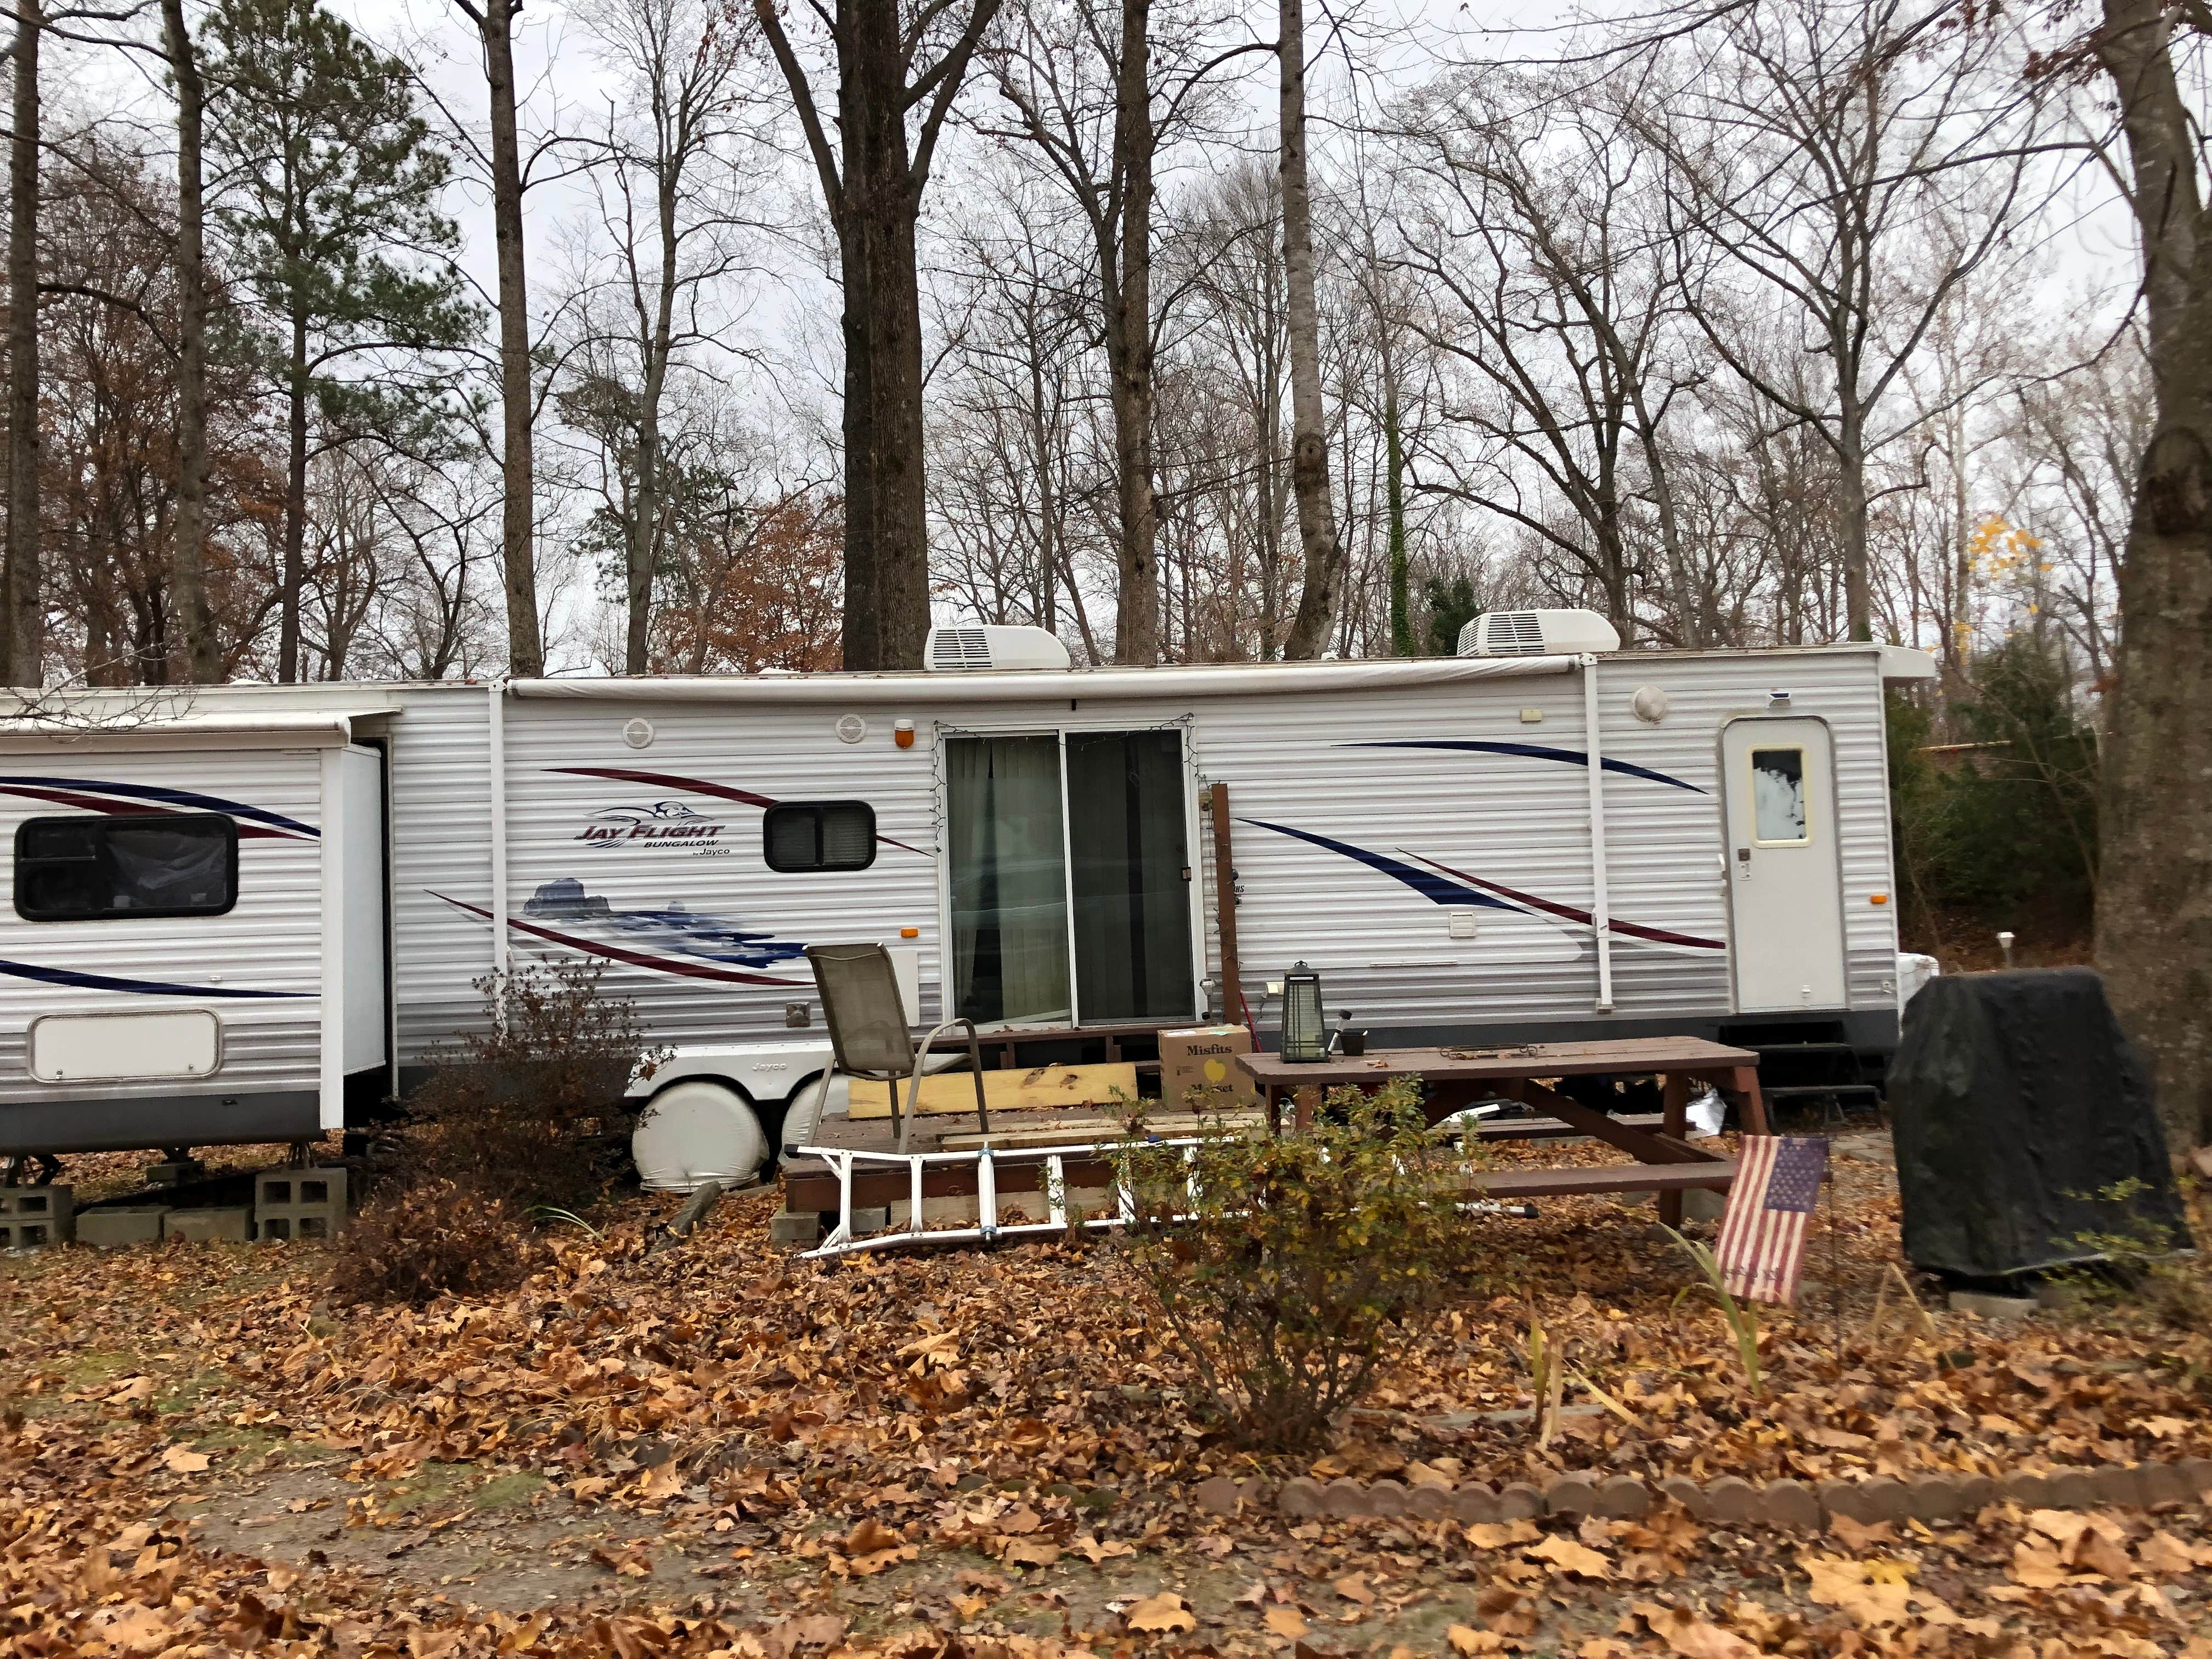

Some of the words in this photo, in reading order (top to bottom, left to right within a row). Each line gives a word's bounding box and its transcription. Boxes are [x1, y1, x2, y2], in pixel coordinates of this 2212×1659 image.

[574, 825, 629, 840] JAY
[627, 825, 725, 839] FLIGHT
[644, 839, 719, 848] BUNGALOW
[1186, 1043, 1233, 1056] Misfits
[752, 1063, 787, 1071] Jayco
